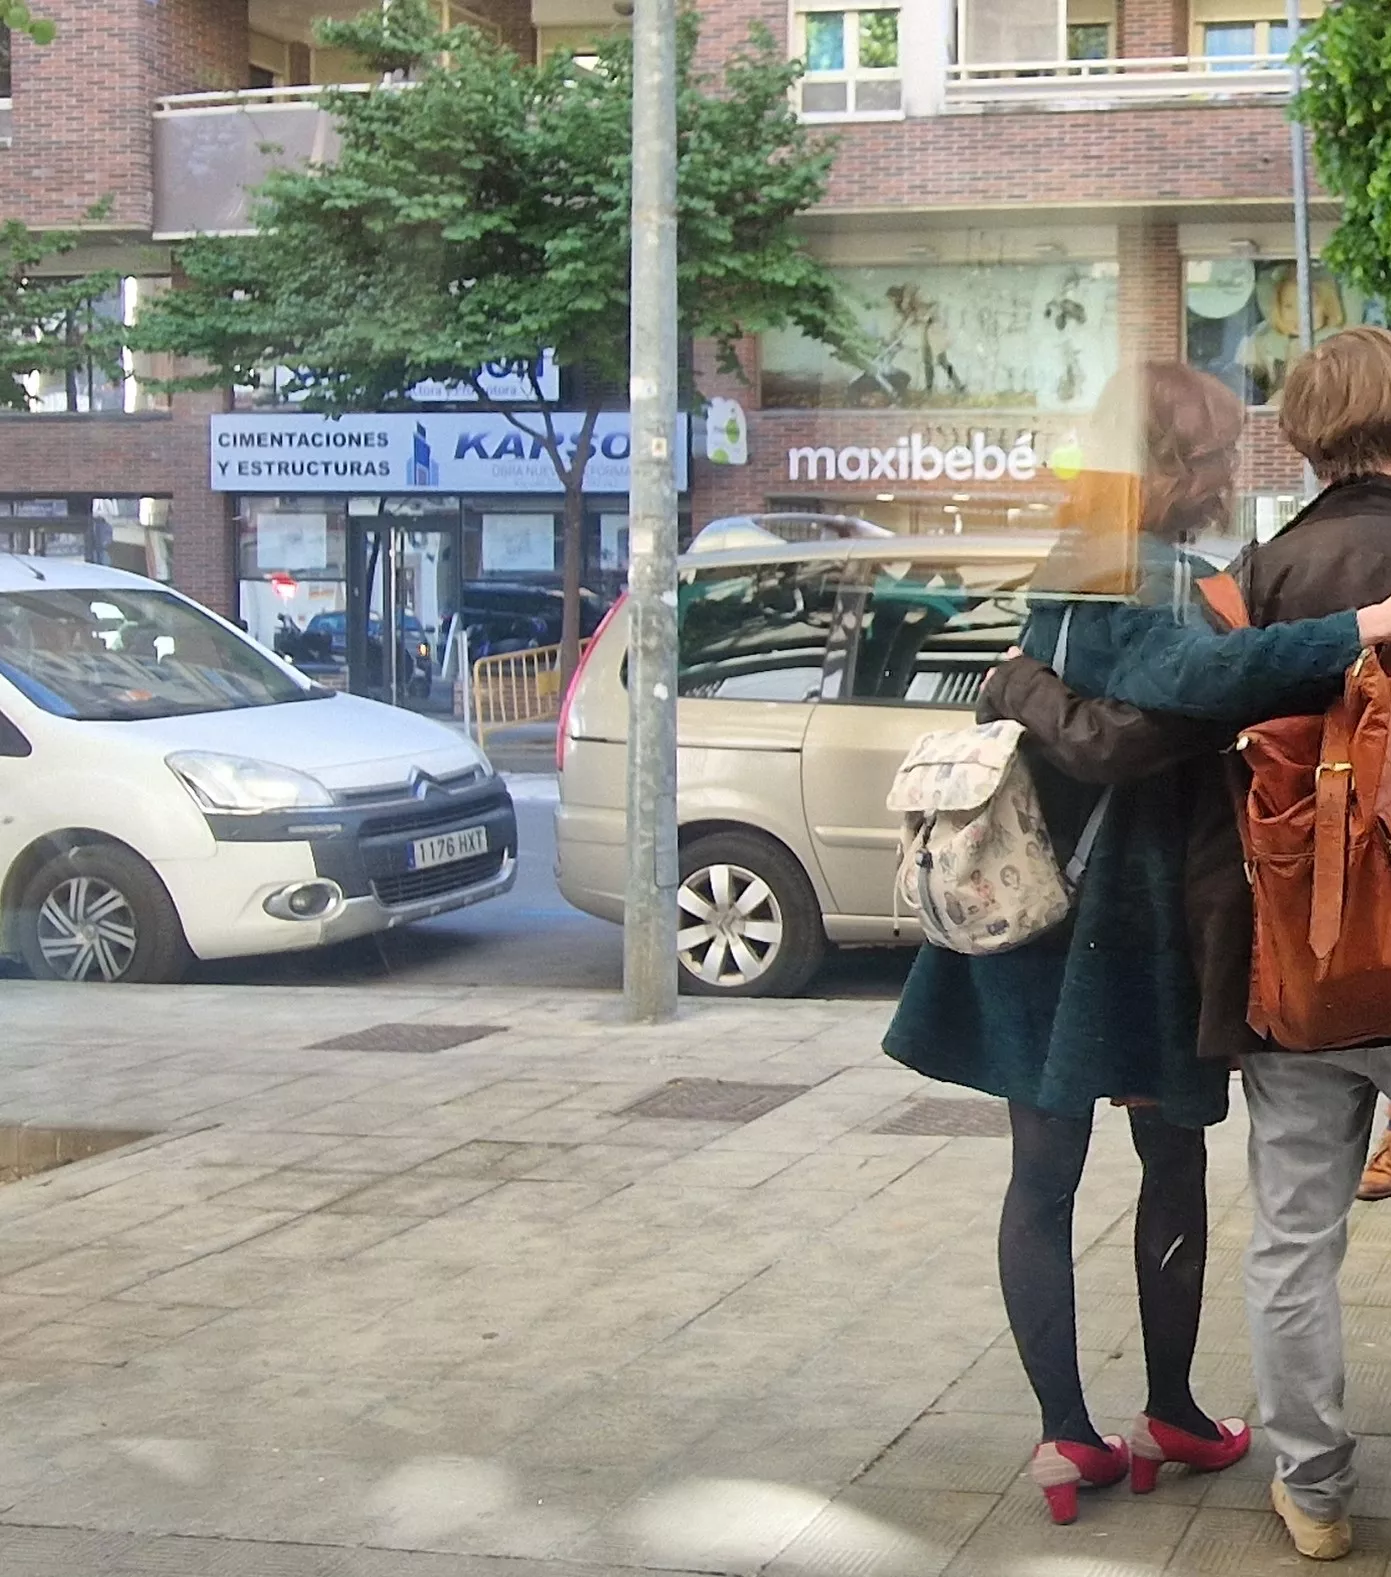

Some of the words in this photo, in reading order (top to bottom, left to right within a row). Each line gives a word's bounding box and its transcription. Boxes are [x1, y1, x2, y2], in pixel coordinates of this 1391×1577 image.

[218, 432, 389, 448] CIMENTACIONES
[217, 461, 229, 476] Y
[238, 460, 391, 476] ESTRUCTURAS
[788, 432, 1036, 481] maxibebé
[420, 837, 455, 862] 1176
[459, 829, 482, 853] HXT
